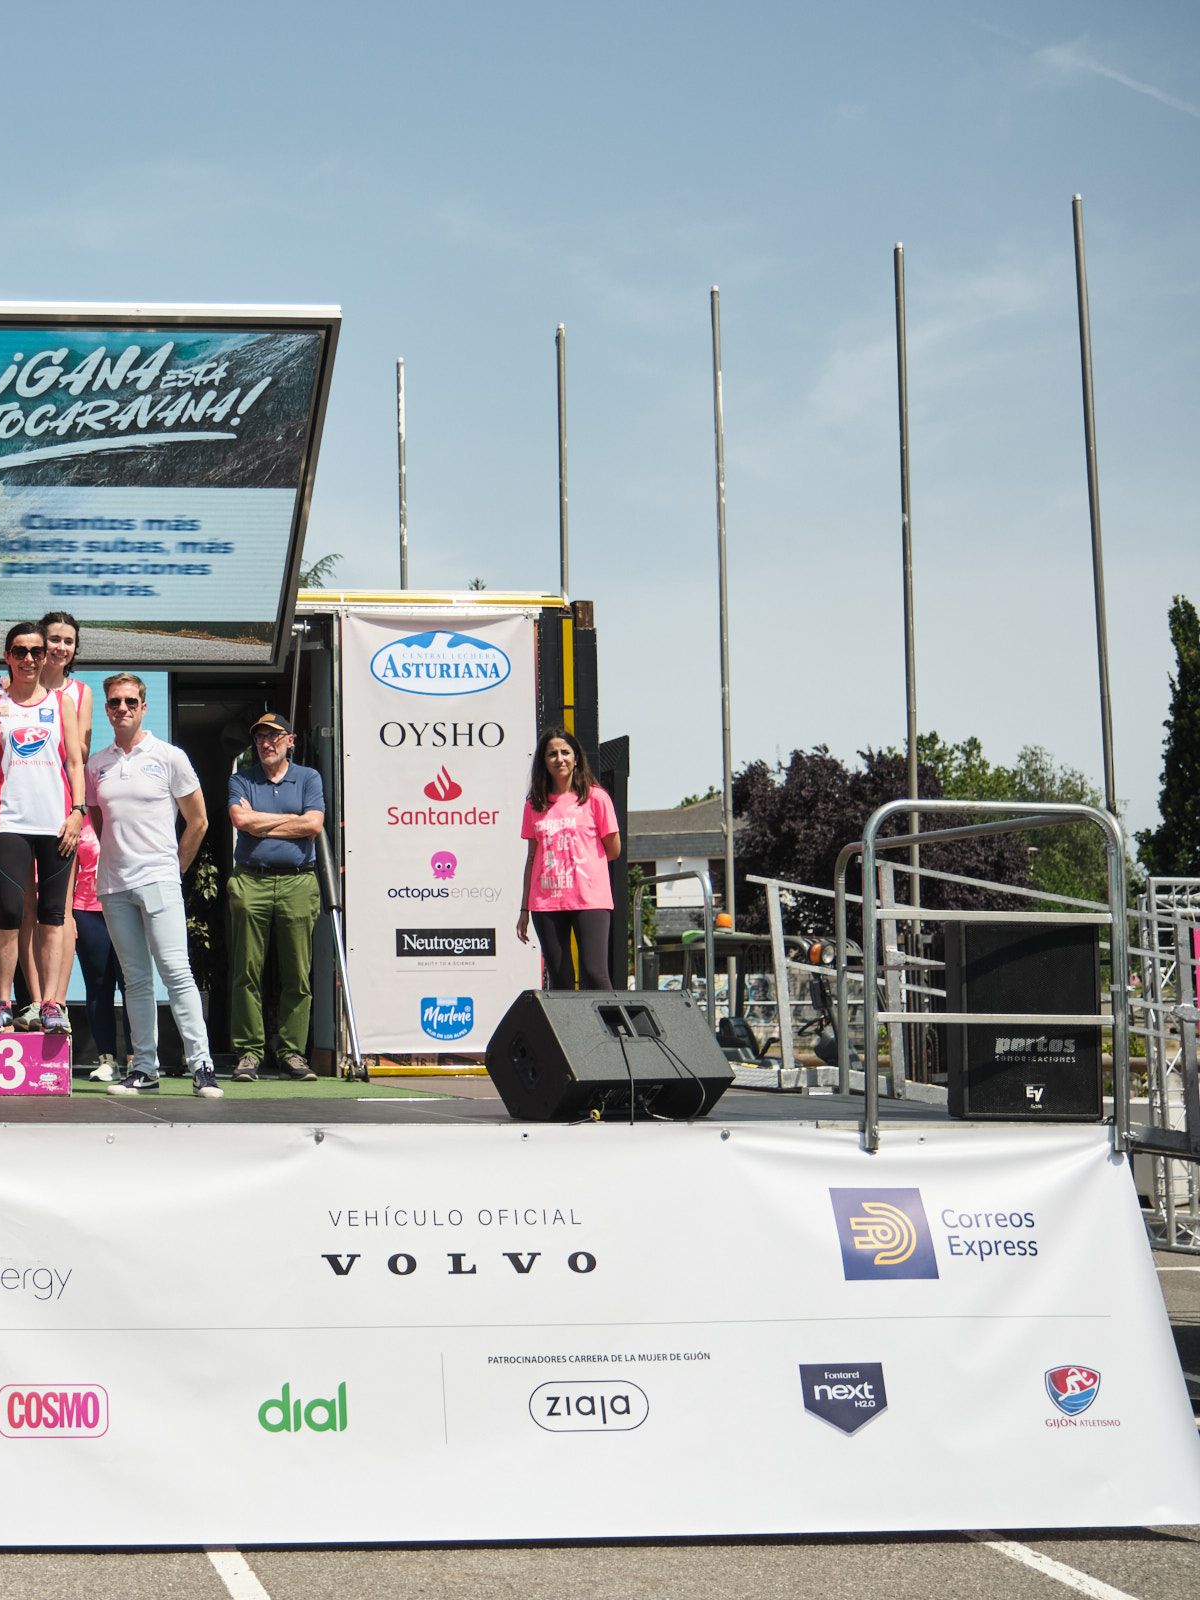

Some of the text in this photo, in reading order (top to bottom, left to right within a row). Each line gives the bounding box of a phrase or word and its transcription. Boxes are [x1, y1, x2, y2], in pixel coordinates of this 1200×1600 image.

[160, 361, 230, 388] ESTA
[382, 654, 501, 679] ASTURIANA
[379, 721, 505, 748] OYSHO
[387, 806, 500, 825] Santander
[388, 885, 503, 903] octopus energy
[402, 934, 490, 954] Neutrogena
[423, 1005, 472, 1030] Marlene
[1026, 1086, 1043, 1102] EV
[328, 1206, 582, 1227] VEHÍCULO OFICIAL
[941, 1209, 1035, 1228] Correos
[947, 1235, 1038, 1262] Express
[321, 1251, 597, 1276] VOLVO
[488, 1351, 711, 1364] PATROCINADORES CARRERA DE LA MUJER DE GIJÓN
[813, 1381, 875, 1401] next
[7, 1391, 100, 1429] COSMO
[257, 1381, 348, 1433] dial
[546, 1394, 631, 1424] ziaja
[1045, 1416, 1121, 1429] GIJÓN ATLETISMO
